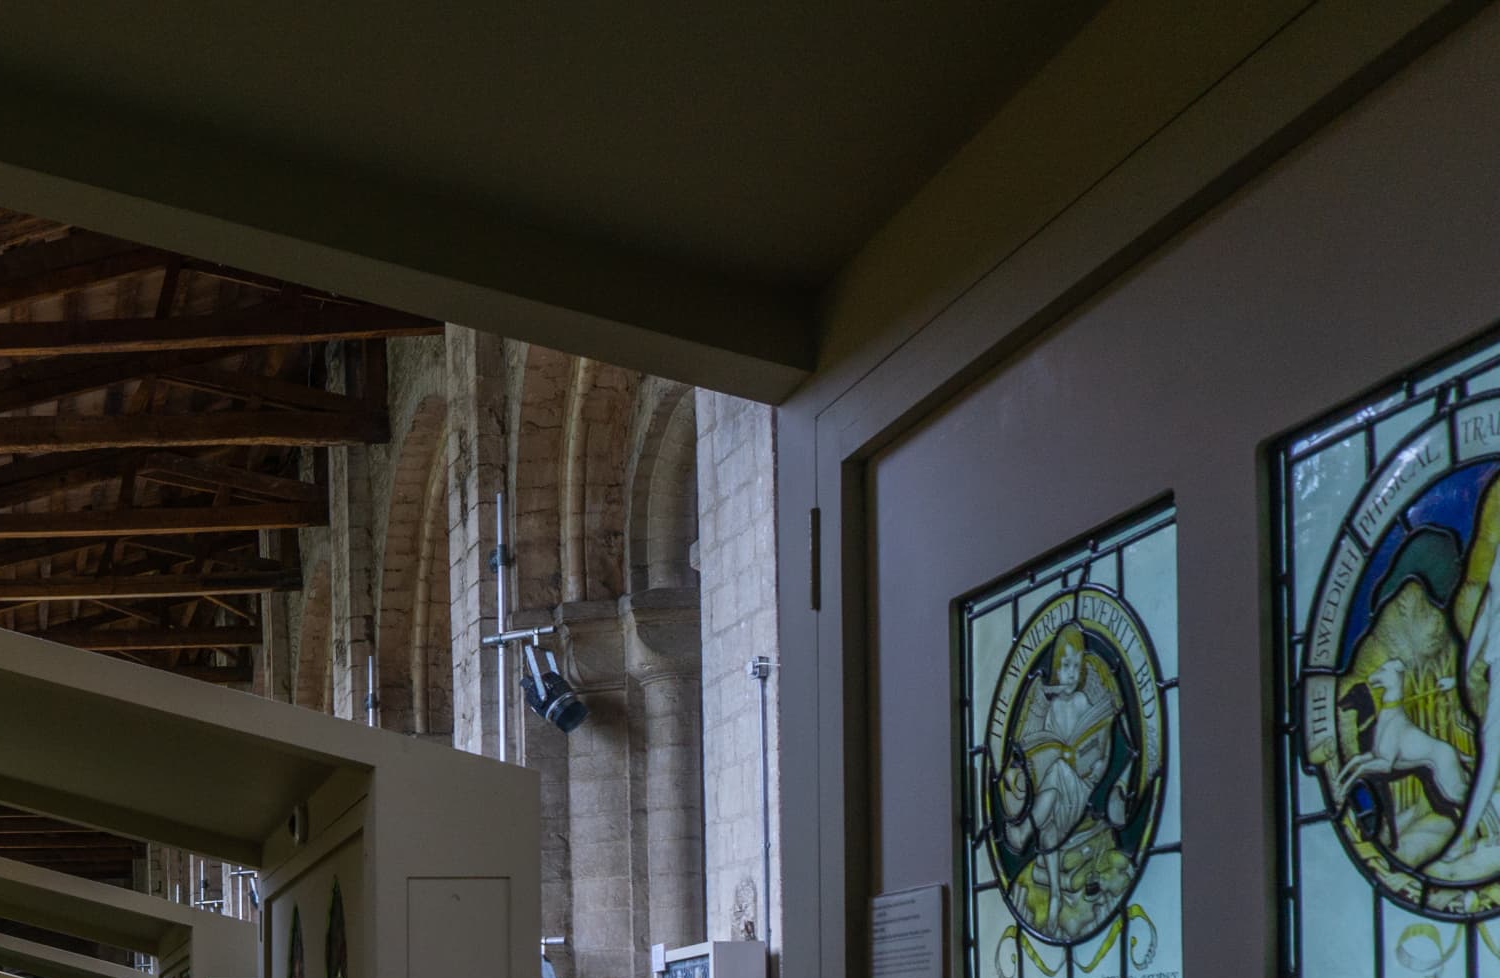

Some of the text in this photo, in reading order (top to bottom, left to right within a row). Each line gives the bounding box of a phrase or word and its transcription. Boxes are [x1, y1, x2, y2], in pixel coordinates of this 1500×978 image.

[1358, 443, 1441, 537] PHYSICAL
[1313, 547, 1360, 663] SWEDISH
[991, 597, 1157, 737] THE WINIFRED EVERITT BED
[1311, 685, 1328, 737] THE
